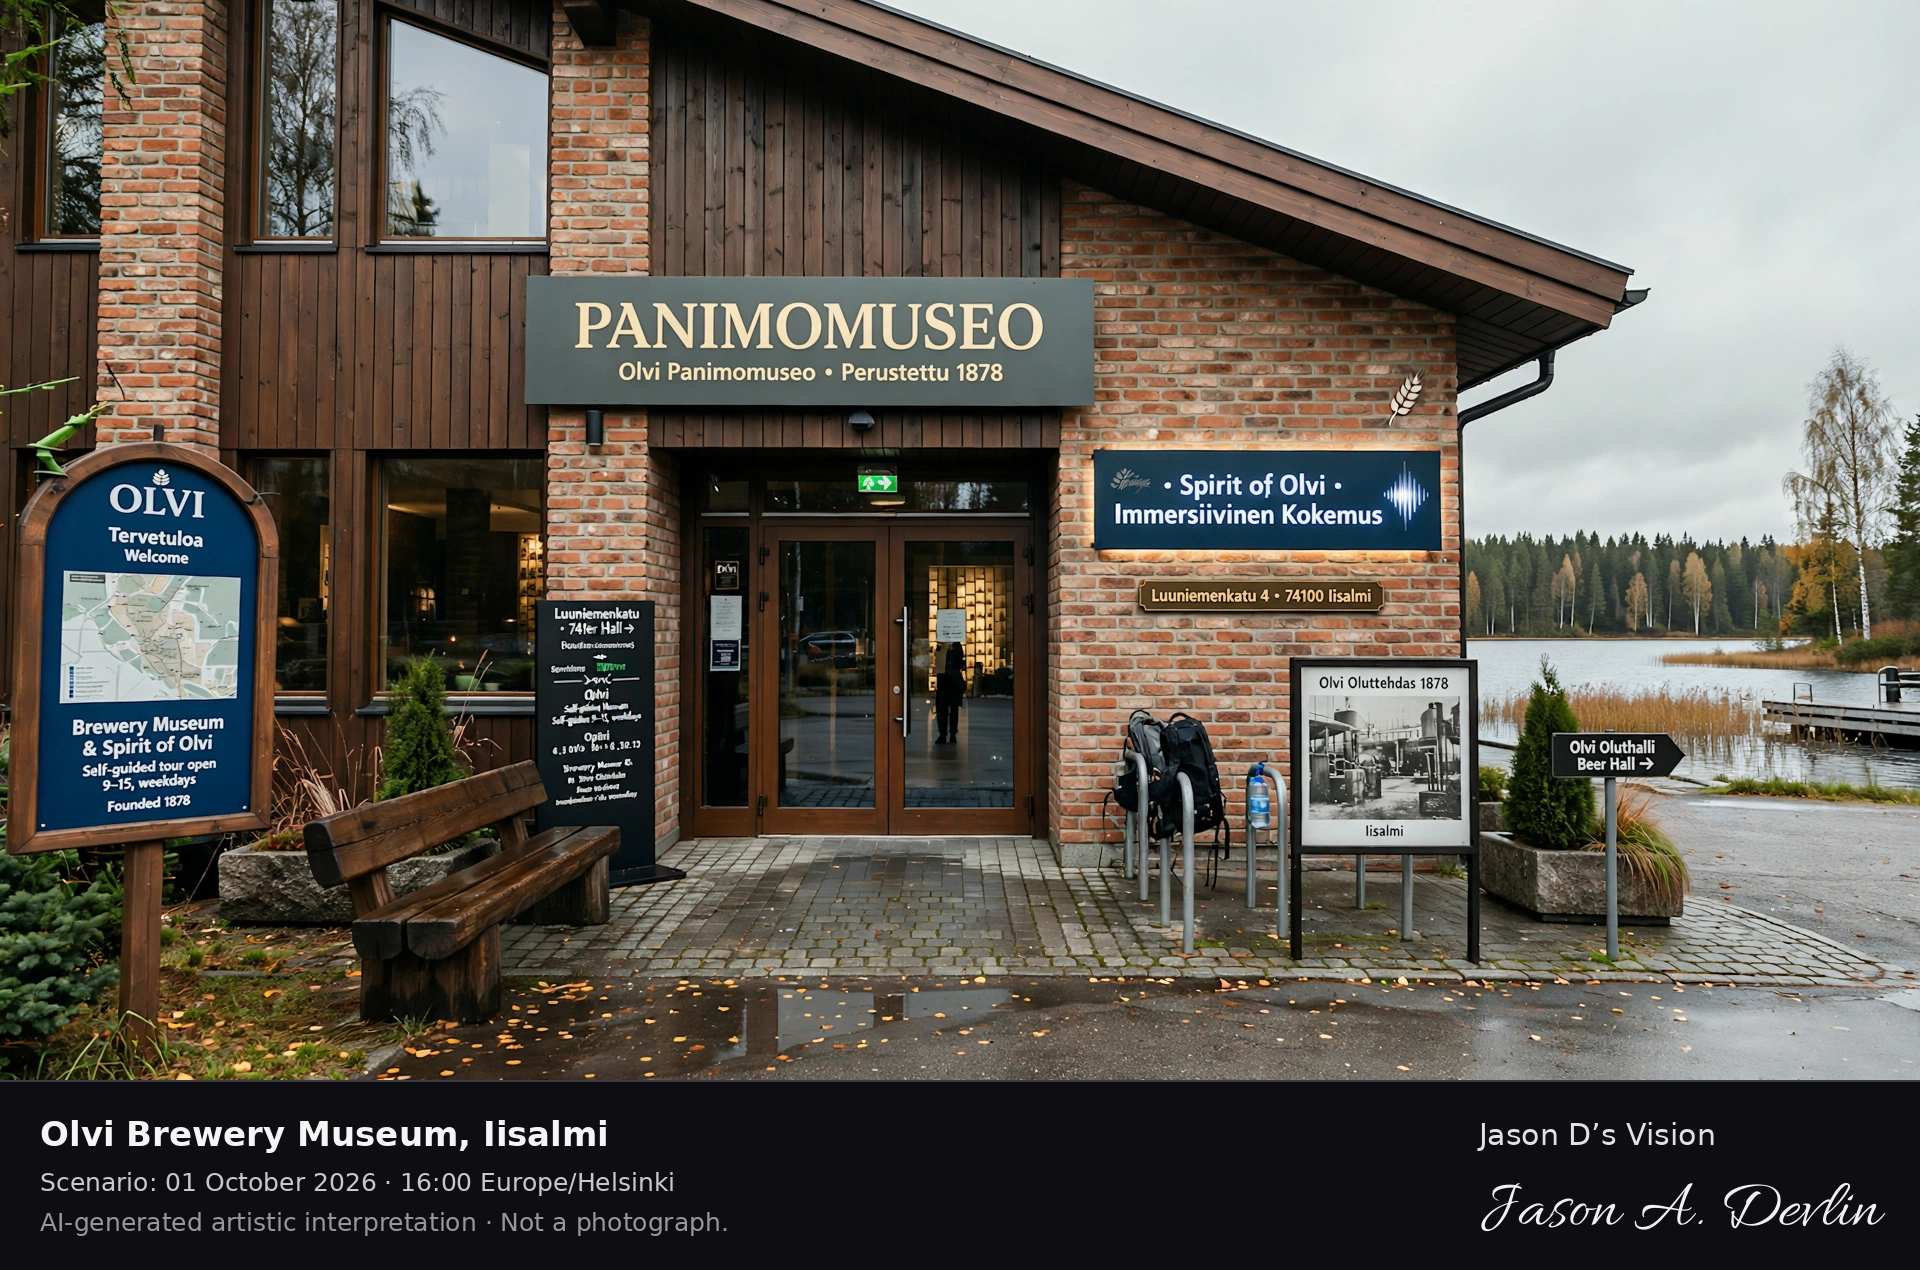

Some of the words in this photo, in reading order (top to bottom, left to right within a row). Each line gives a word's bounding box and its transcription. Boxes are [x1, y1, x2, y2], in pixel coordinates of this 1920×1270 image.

[574, 302, 1044, 351] PANIMOMUSEO
[618, 360, 660, 381] Olvi
[668, 361, 816, 382] Panimomuseo
[842, 362, 949, 382] Perustettu
[956, 362, 1004, 382] 1878
[1180, 473, 1243, 501] Spirit
[1248, 472, 1274, 499] of
[1279, 472, 1326, 496] Olvi
[109, 482, 205, 519] OLVI
[1115, 502, 1275, 525] Immersiivinen
[1282, 502, 1383, 525] Kokemus
[107, 526, 204, 548] Tervetuloa
[123, 548, 190, 565] Welcome
[1151, 587, 1257, 603] Luuniemenkatu
[1259, 588, 1270, 603] 4
[1284, 588, 1324, 603] 74100
[1328, 588, 1372, 603] Iisalmi
[554, 606, 640, 620] Luuniemenkatu
[600, 620, 623, 636] Hall
[1319, 675, 1344, 689] Olvi
[1347, 675, 1416, 689] Oluttehdas
[1420, 676, 1449, 690] 1878
[72, 719, 149, 737] Brewery
[152, 716, 225, 733] Museum
[82, 740, 98, 757] &
[102, 737, 152, 760] Spirit
[155, 735, 176, 753] of
[178, 734, 213, 752] Olvi
[1569, 739, 1596, 755] Olvi
[1599, 739, 1656, 755] Oluthalli
[82, 760, 157, 778] Self-guided
[158, 761, 185, 773] tour
[186, 760, 217, 773] open
[1577, 757, 1607, 771] Beer
[1609, 756, 1636, 771] Hall
[137, 773, 197, 789] weekdays
[107, 796, 161, 813] Founded
[163, 794, 191, 808] 1878
[1365, 824, 1405, 838] Iisalmi
